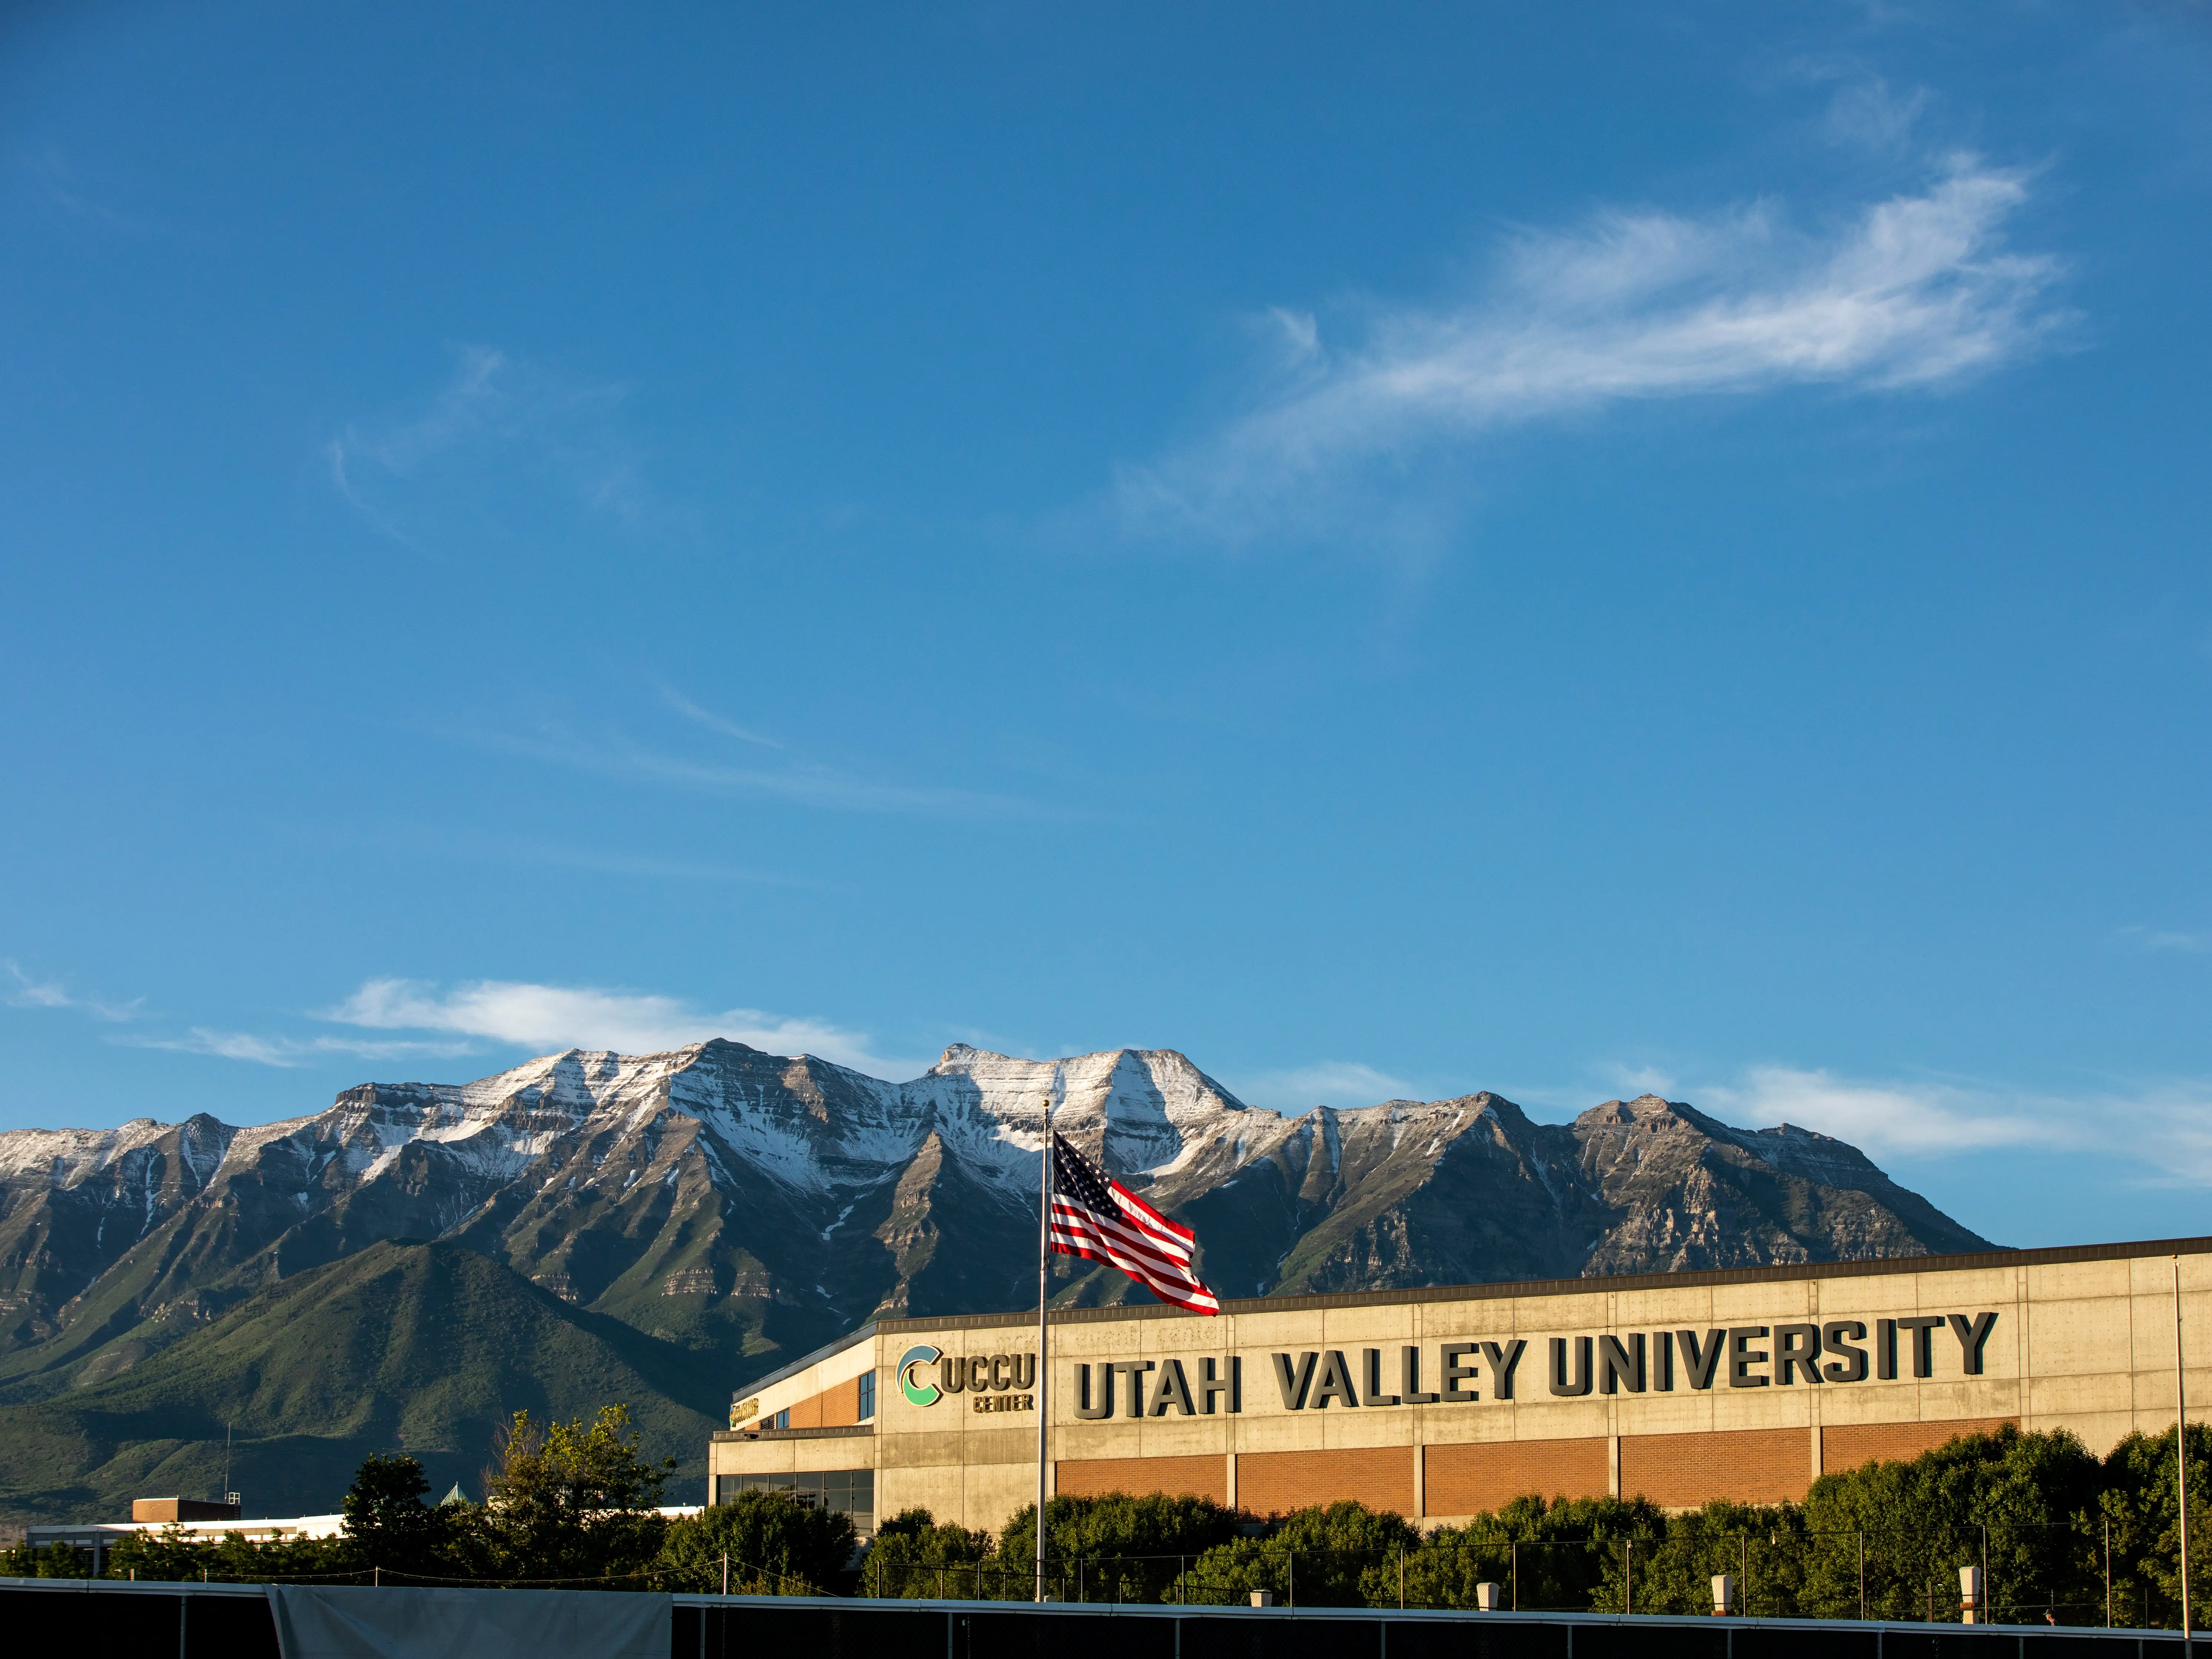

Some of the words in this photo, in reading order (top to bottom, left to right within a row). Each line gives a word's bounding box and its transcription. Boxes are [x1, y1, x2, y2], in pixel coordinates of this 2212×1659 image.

[941, 1353, 1035, 1393] UCCU
[1074, 1356, 1241, 1419] UTAH
[1271, 1339, 1527, 1410] VALLEY
[1549, 1312, 1999, 1396] UNIVERSITY
[973, 1394, 1033, 1413] CENTER
